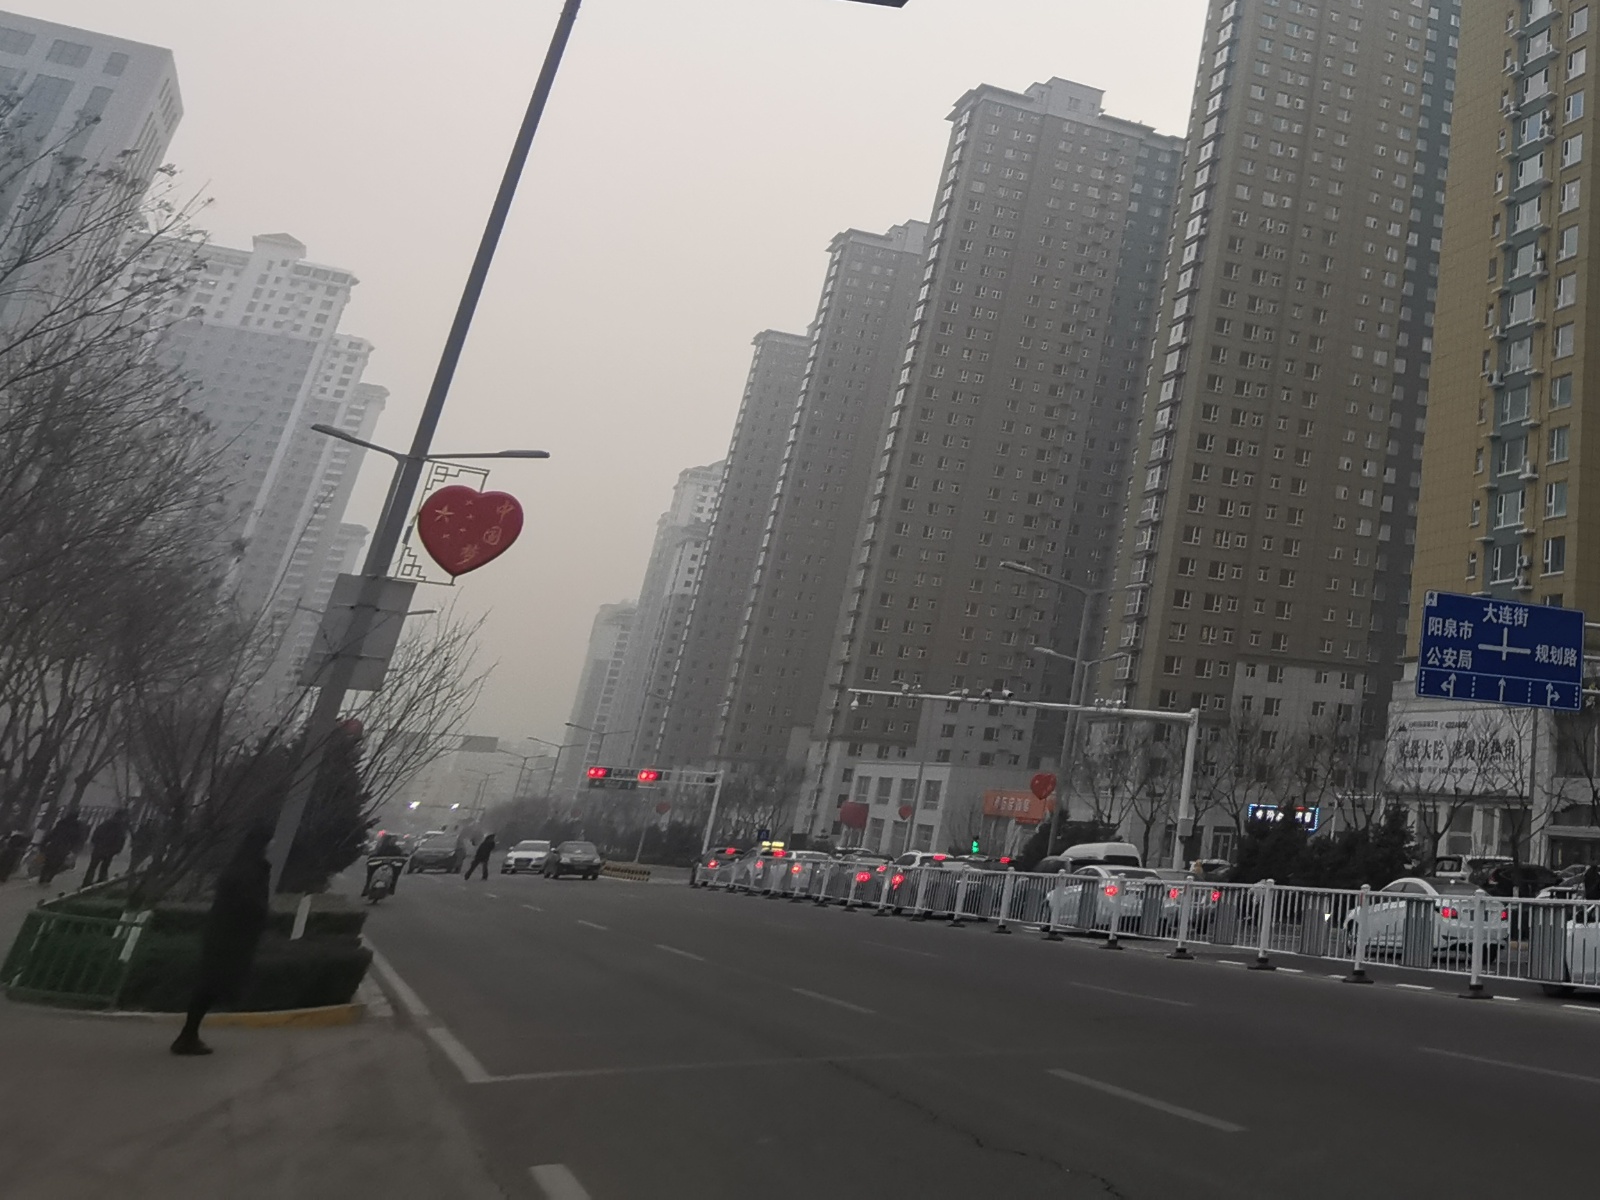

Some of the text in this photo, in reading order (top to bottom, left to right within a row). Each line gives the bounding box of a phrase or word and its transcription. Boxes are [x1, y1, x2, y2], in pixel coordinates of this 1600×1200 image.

[1482, 603, 1529, 628] 大连街
[1427, 616, 1474, 640] 阳泉市
[1426, 646, 1473, 670] 公安局
[1535, 644, 1578, 668] 规划路
